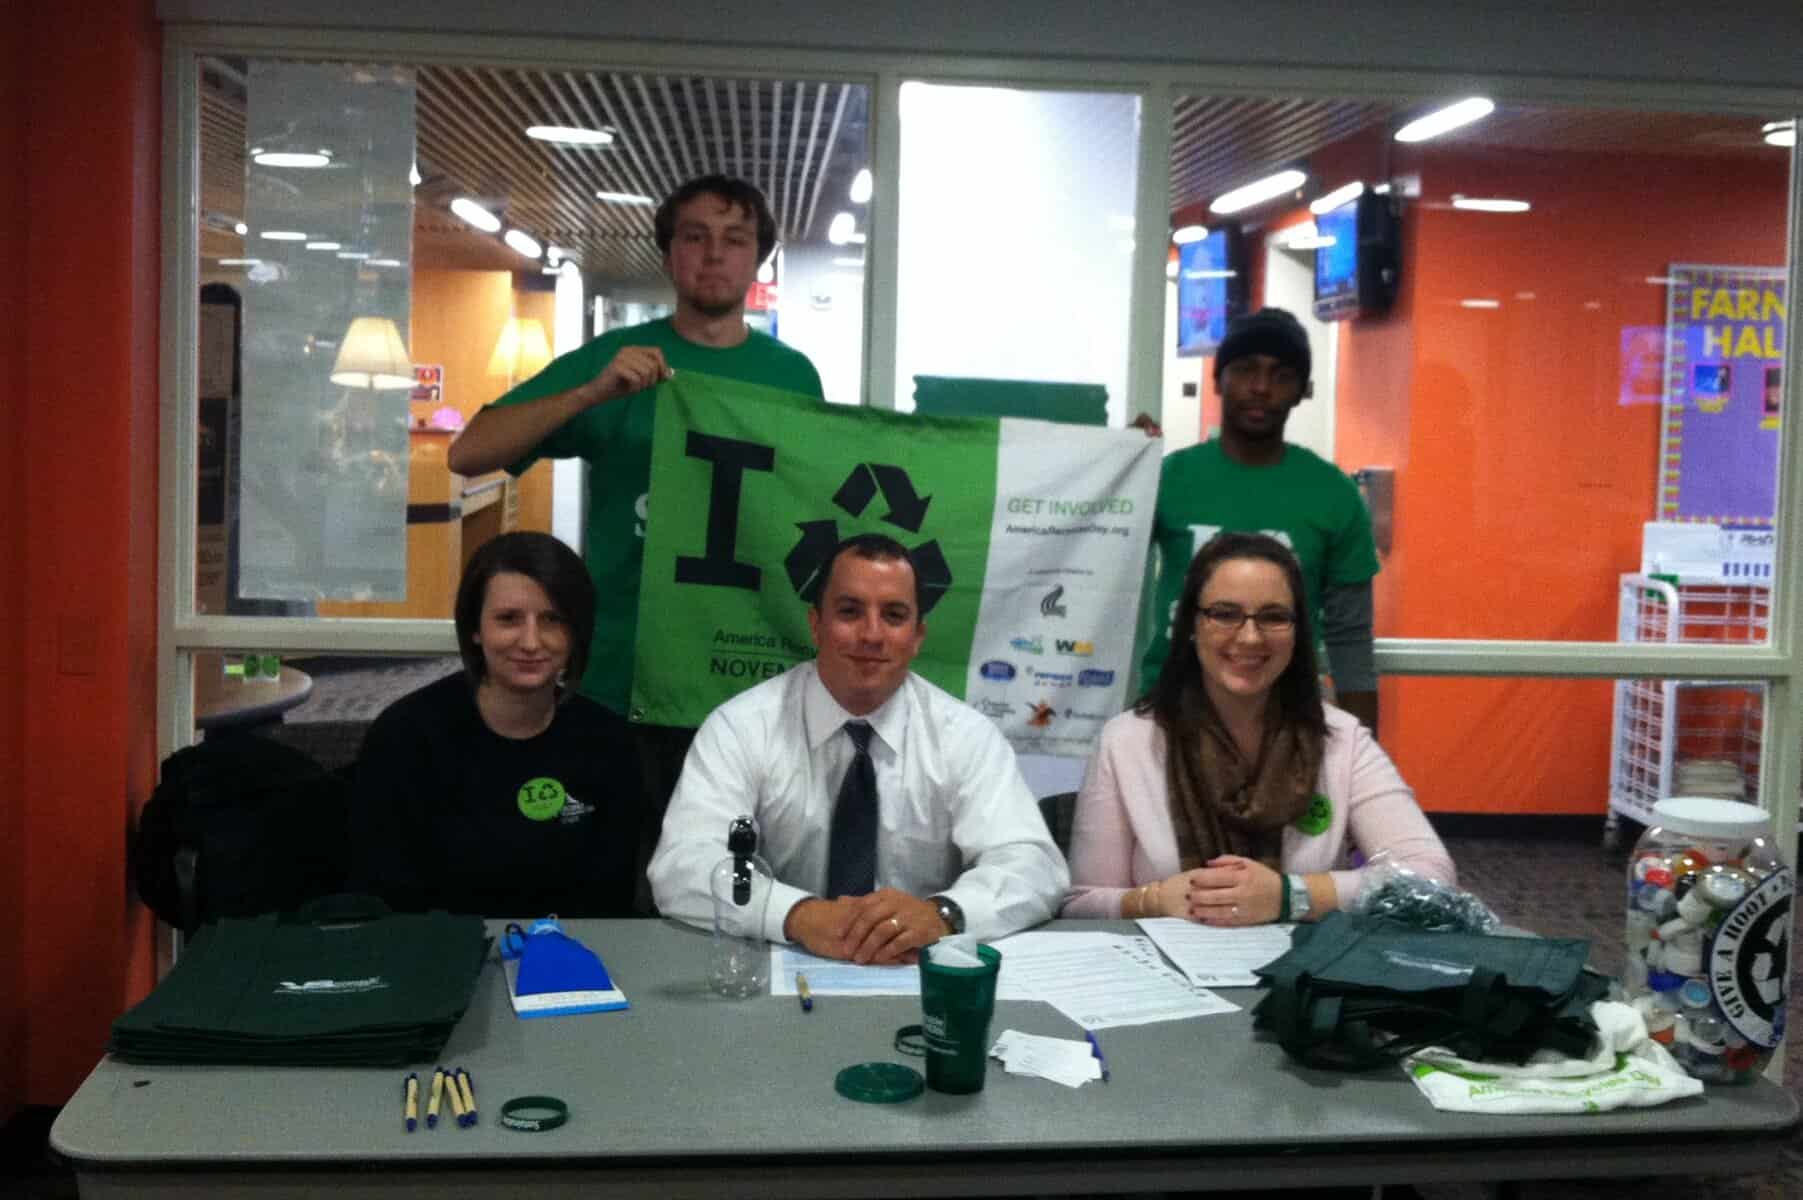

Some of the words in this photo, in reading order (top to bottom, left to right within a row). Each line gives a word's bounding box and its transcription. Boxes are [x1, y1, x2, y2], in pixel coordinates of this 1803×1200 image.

[1703, 326, 1784, 358] HAL
[674, 430, 775, 592] I
[1007, 498, 1042, 514] GET
[1049, 497, 1135, 517] INVOLVED
[712, 627, 777, 649] America
[1716, 947, 1736, 963] A
[1716, 970, 1745, 1019] GIVE
